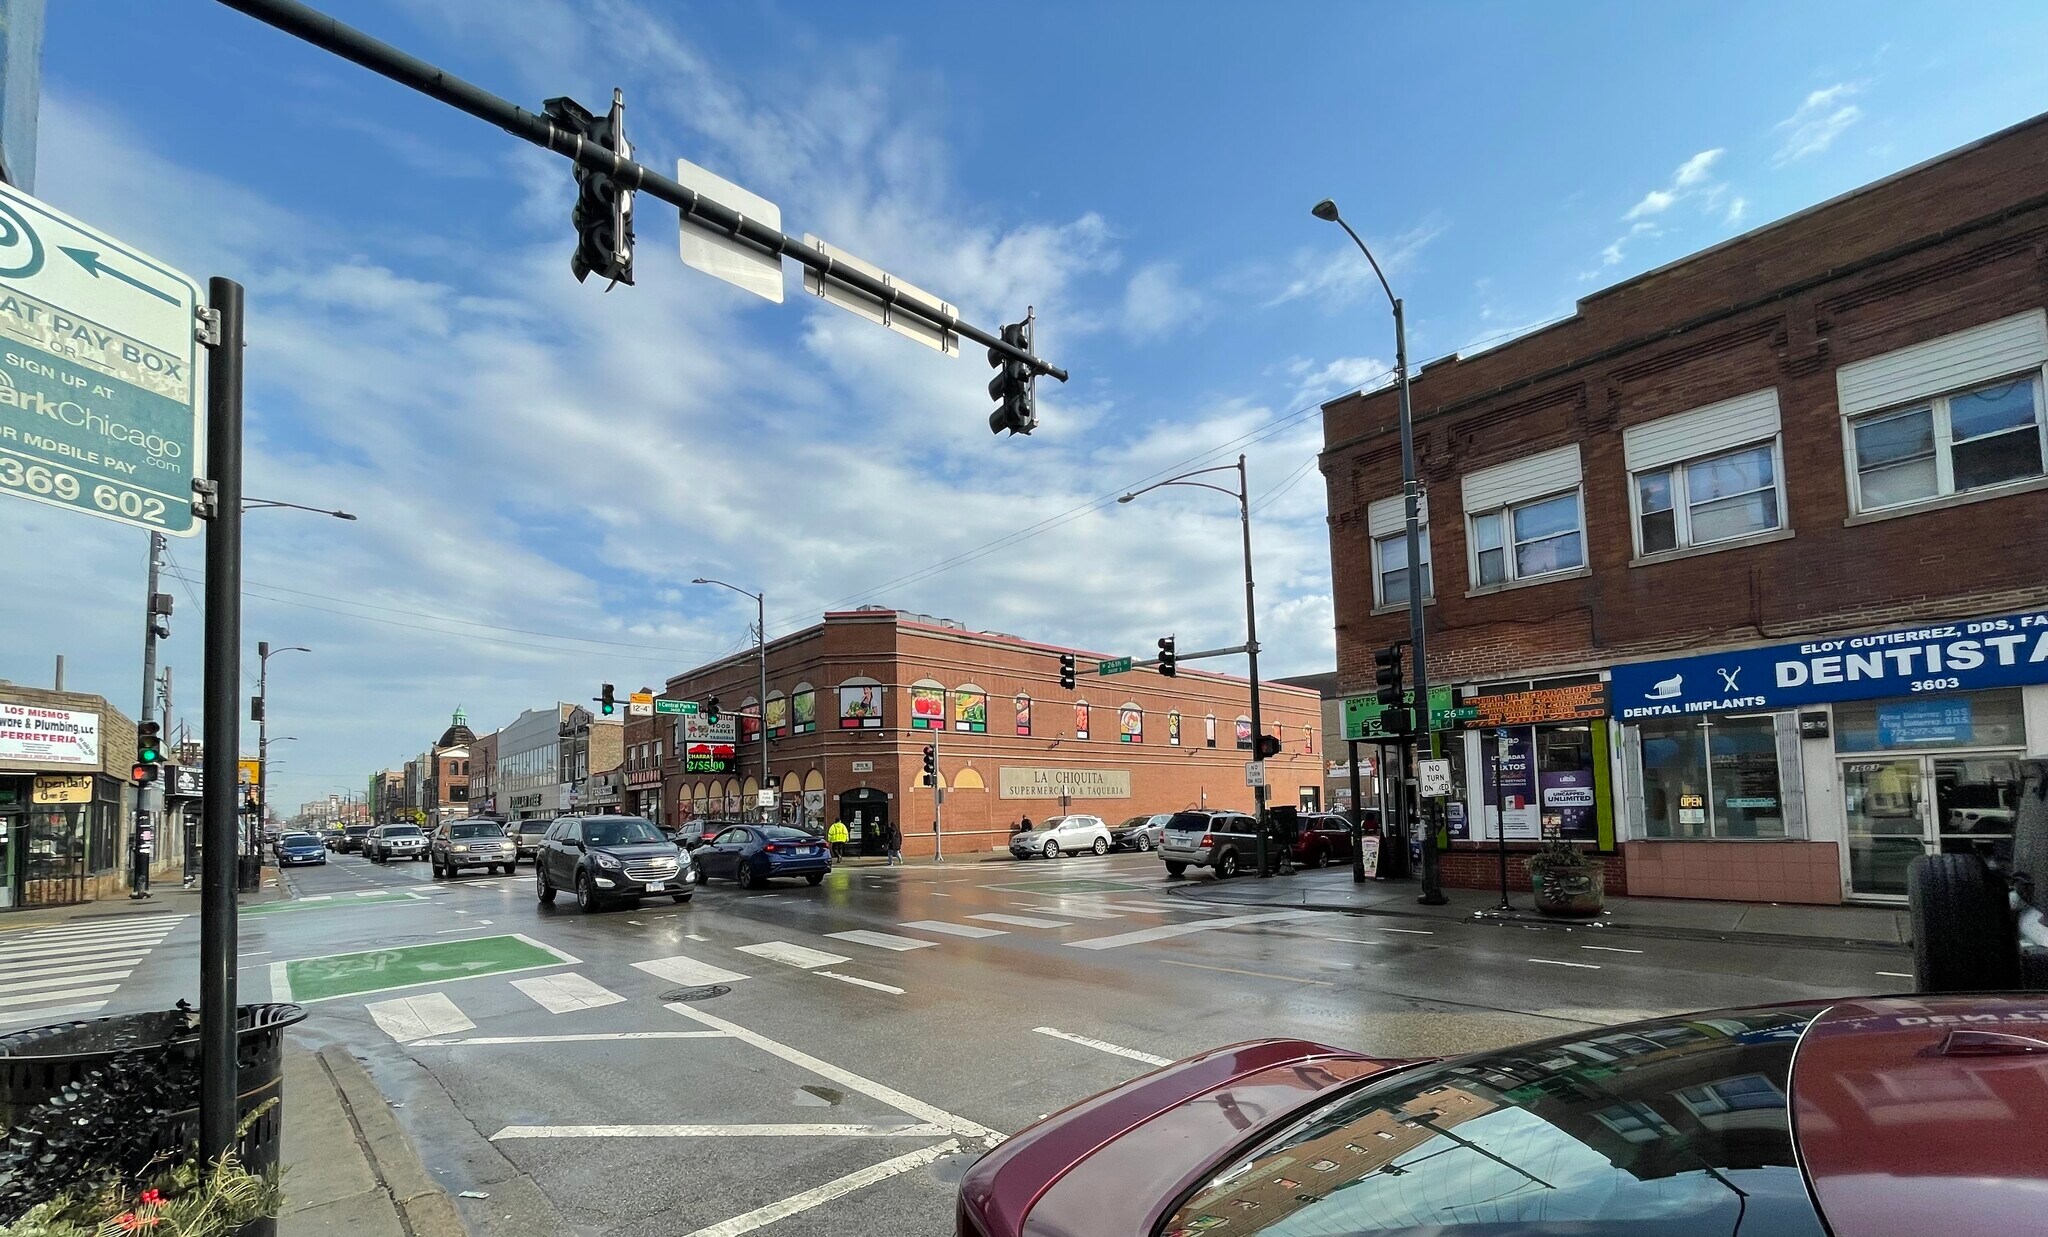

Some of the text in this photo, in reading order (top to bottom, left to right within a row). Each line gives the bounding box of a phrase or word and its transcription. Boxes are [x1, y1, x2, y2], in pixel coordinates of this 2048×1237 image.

[0, 296, 182, 382] AT PAY BOX
[50, 341, 76, 358] OR
[5, 352, 115, 400] SIGN UP AT
[24, 432, 99, 464] MOBILE
[104, 456, 137, 475] PAY
[0, 457, 166, 525] 369 602
[1801, 640, 1845, 655] ELOY
[1850, 626, 1962, 648] GUTIERREZ,
[1967, 619, 2015, 635] DDS,
[1911, 677, 1960, 693] 3603
[5, 706, 70, 720] LOS MISMOS
[1623, 696, 1766, 718] DENTAL IMPLANTS
[25, 718, 31, 729] &
[81, 726, 94, 734] LLC
[0, 731, 77, 744] FERRETERIA
[36, 778, 66, 790] Open
[1034, 771, 1104, 786] LA CHIQUITA
[1087, 787, 1124, 796] TAQUERIA
[1681, 797, 1703, 807] OPEN
